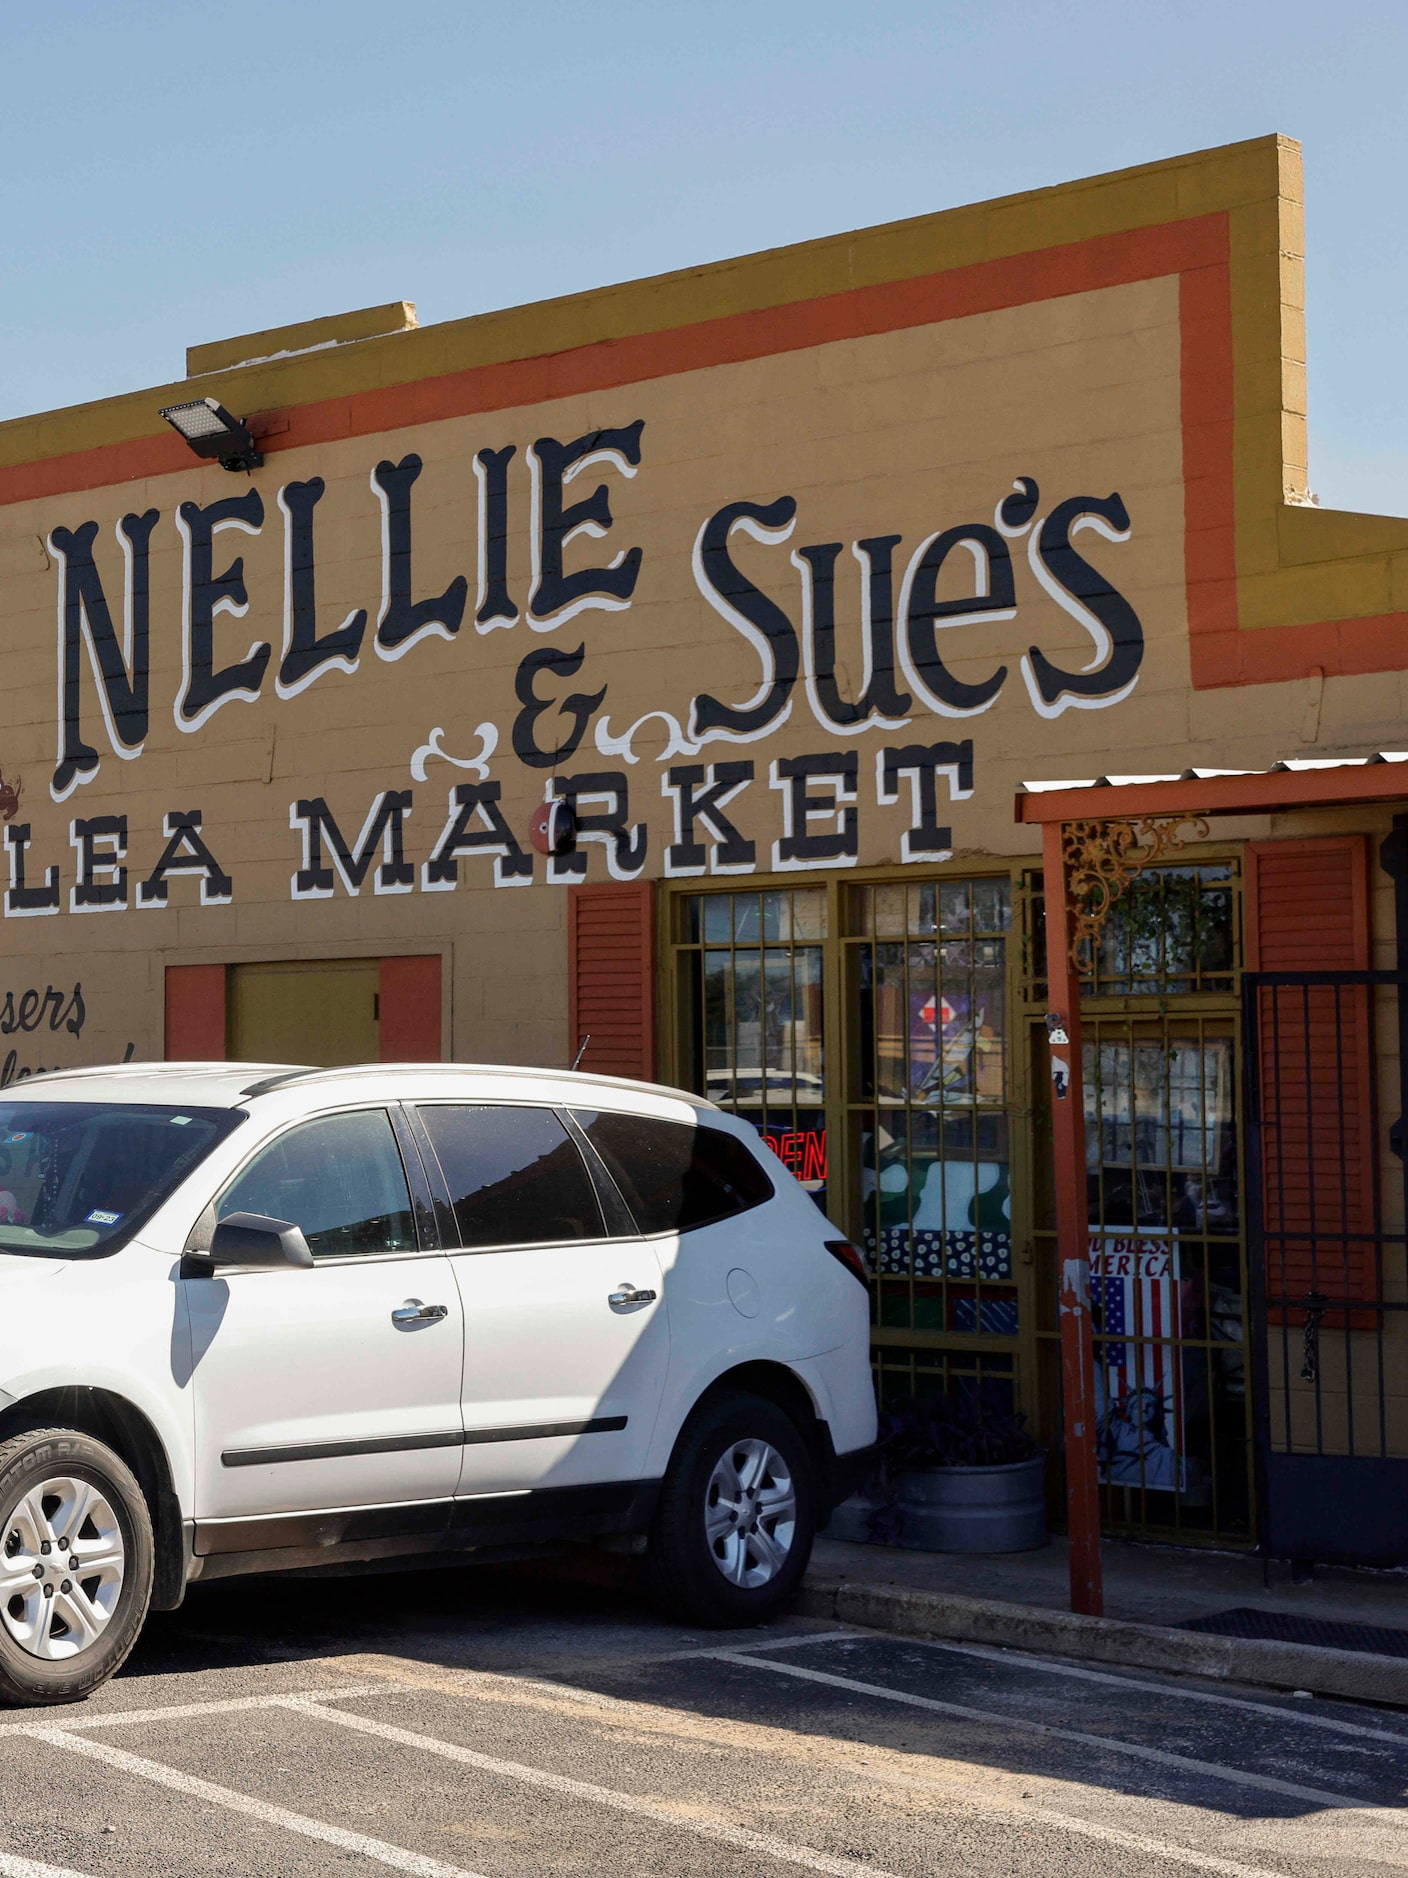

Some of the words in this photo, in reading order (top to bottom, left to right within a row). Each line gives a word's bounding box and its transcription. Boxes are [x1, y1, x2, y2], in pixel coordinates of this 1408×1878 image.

[48, 419, 645, 802] NELLIE
[512, 642, 608, 768] &
[692, 476, 1144, 745] Sue's
[292, 739, 974, 900] MARKET
[1088, 1254, 1169, 1277] MERICA
